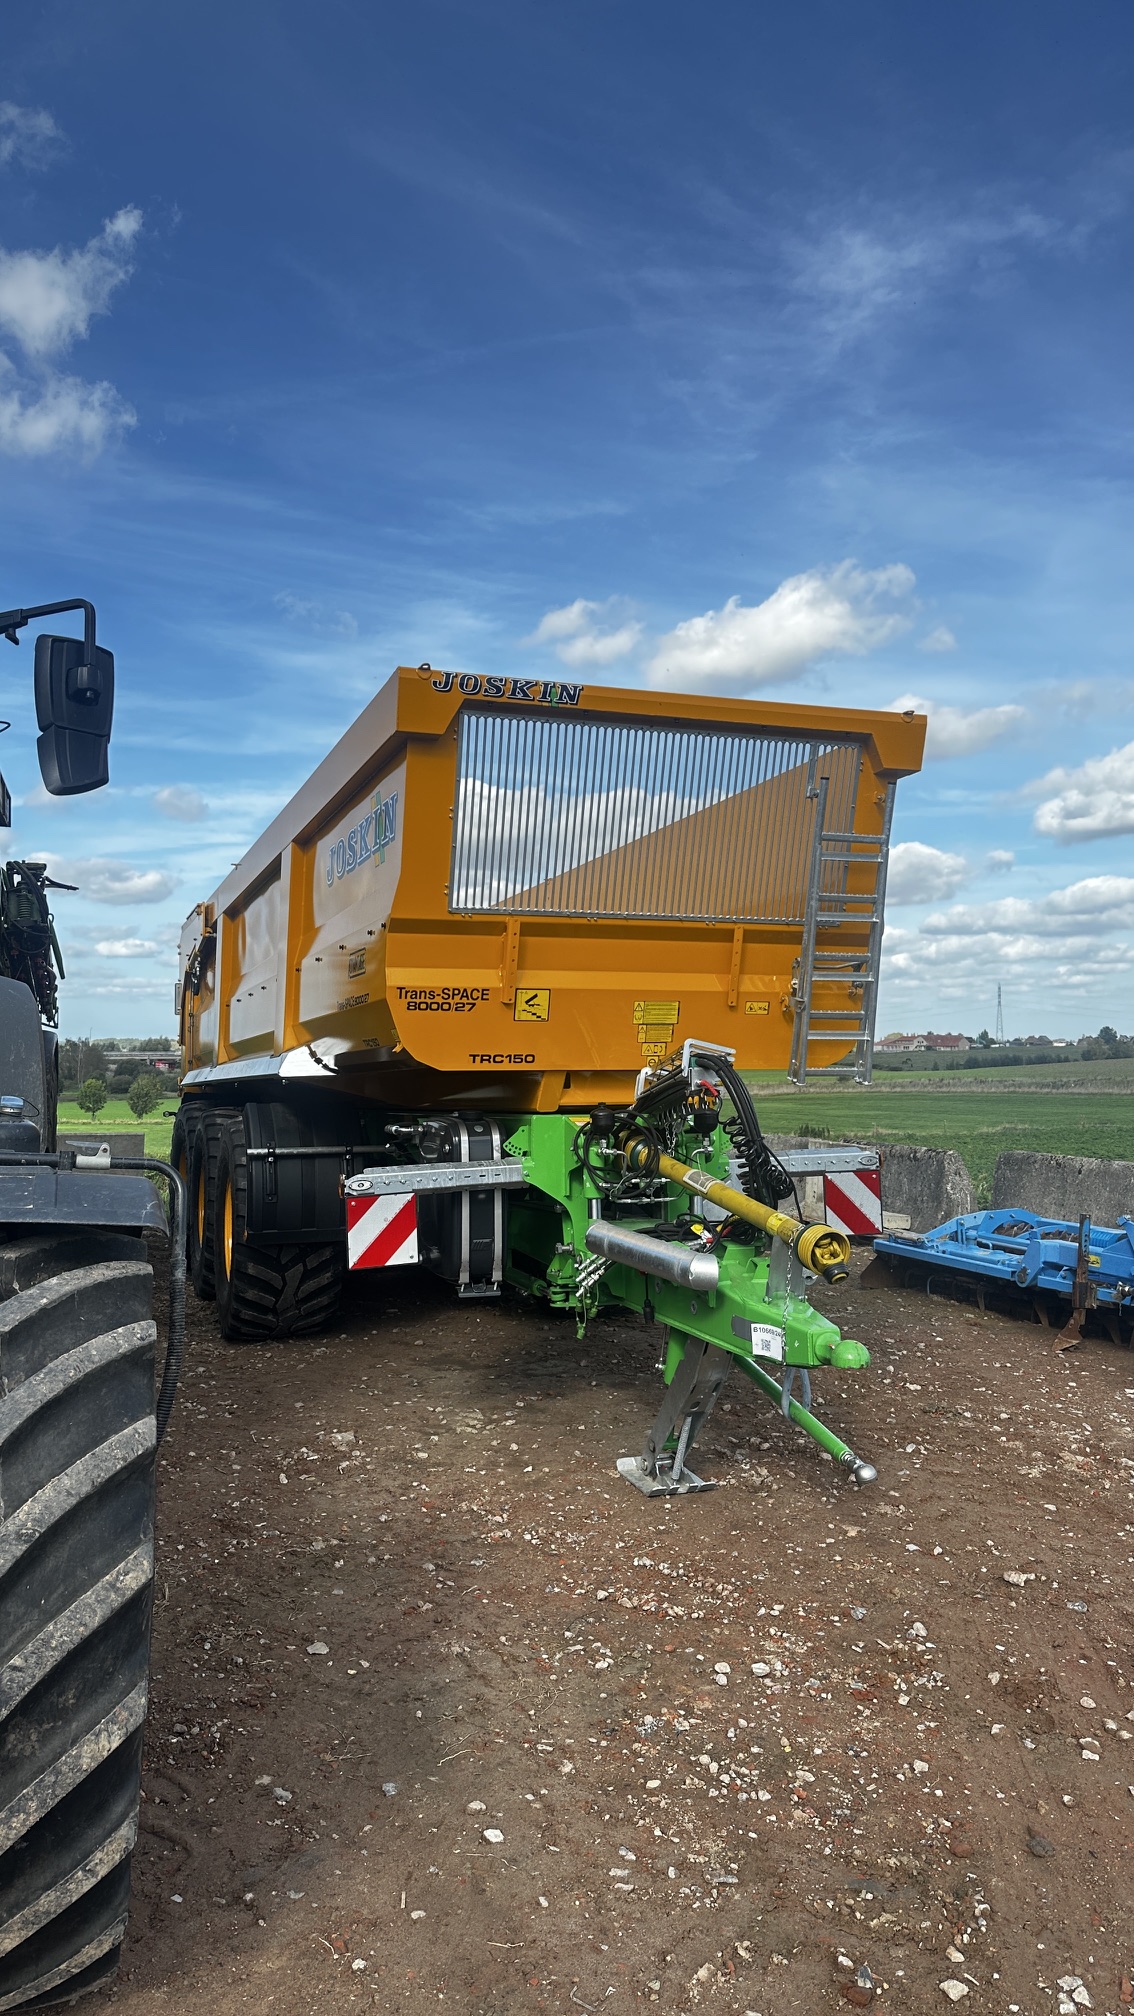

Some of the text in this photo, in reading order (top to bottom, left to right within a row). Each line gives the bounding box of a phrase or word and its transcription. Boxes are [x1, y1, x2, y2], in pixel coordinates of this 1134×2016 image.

[432, 671, 584, 705] JOSKIN
[326, 791, 398, 888] JOSKIN
[396, 987, 490, 1001] Trans-SPACE
[406, 1002, 477, 1012] 8000/27
[469, 1054, 536, 1064] TRC150
